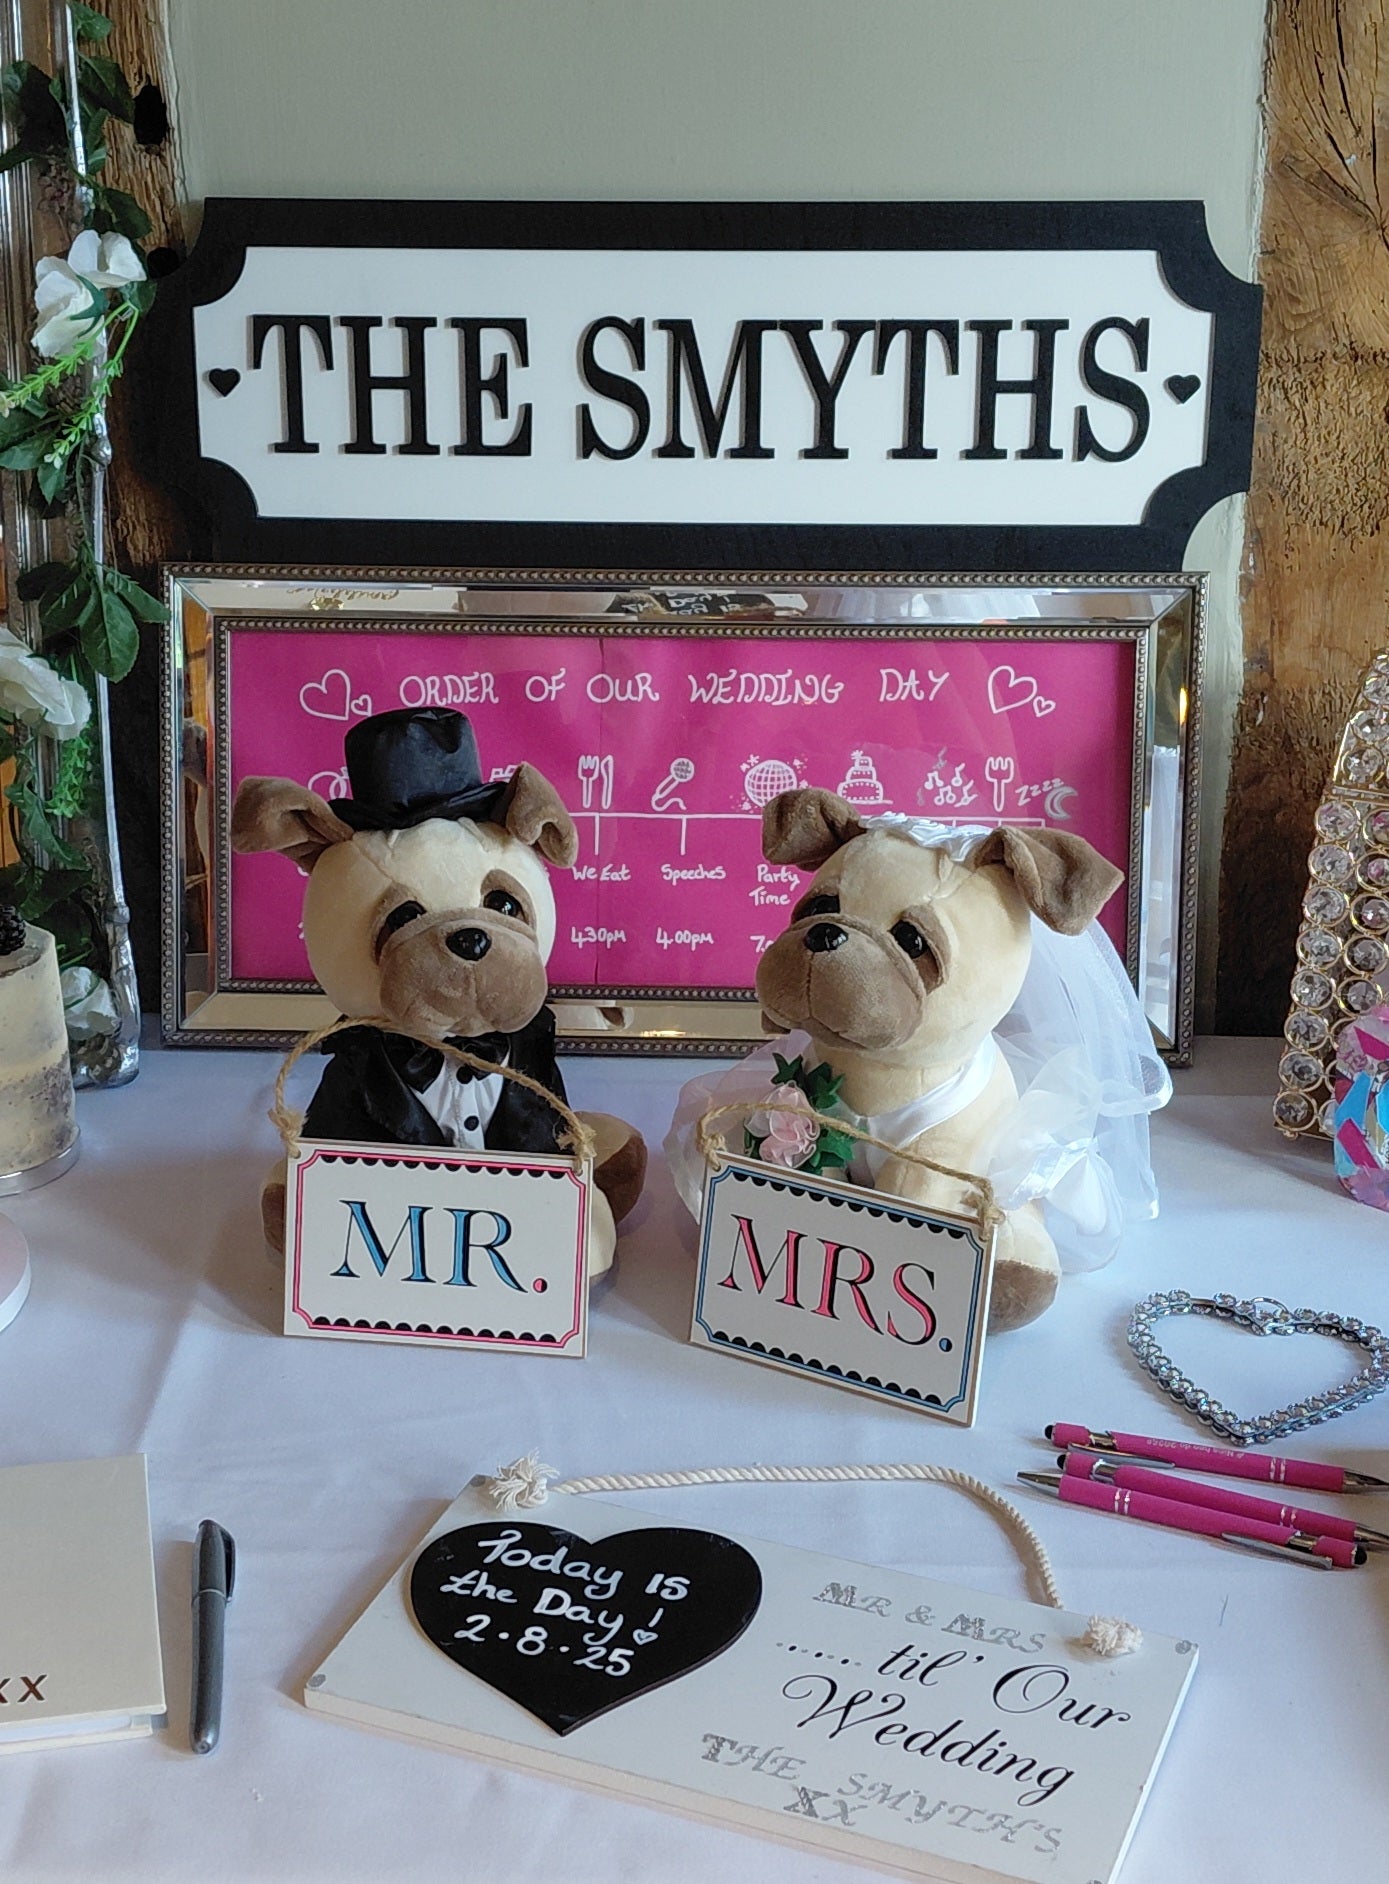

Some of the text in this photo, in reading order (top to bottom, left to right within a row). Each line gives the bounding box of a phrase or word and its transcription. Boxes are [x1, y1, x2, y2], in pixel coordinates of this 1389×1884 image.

[246, 315, 1150, 463] THE SMYTHS
[400, 668, 950, 707] ORDER OF OUR WEDDING DAY
[572, 864, 631, 881] We Eat
[661, 864, 726, 886] Speeches
[749, 886, 791, 906] Time
[757, 864, 800, 891] Party
[330, 1199, 548, 1294] MR.
[717, 1214, 954, 1353] MRS.
[440, 1570, 517, 1603] the
[478, 1529, 623, 1600] Today
[812, 1582, 1047, 1654] MR & MRS
[992, 1664, 1131, 1729] Our
[701, 1733, 807, 1781] THE
[782, 1674, 1075, 1807] Wedding
[783, 1785, 867, 1826] XX
